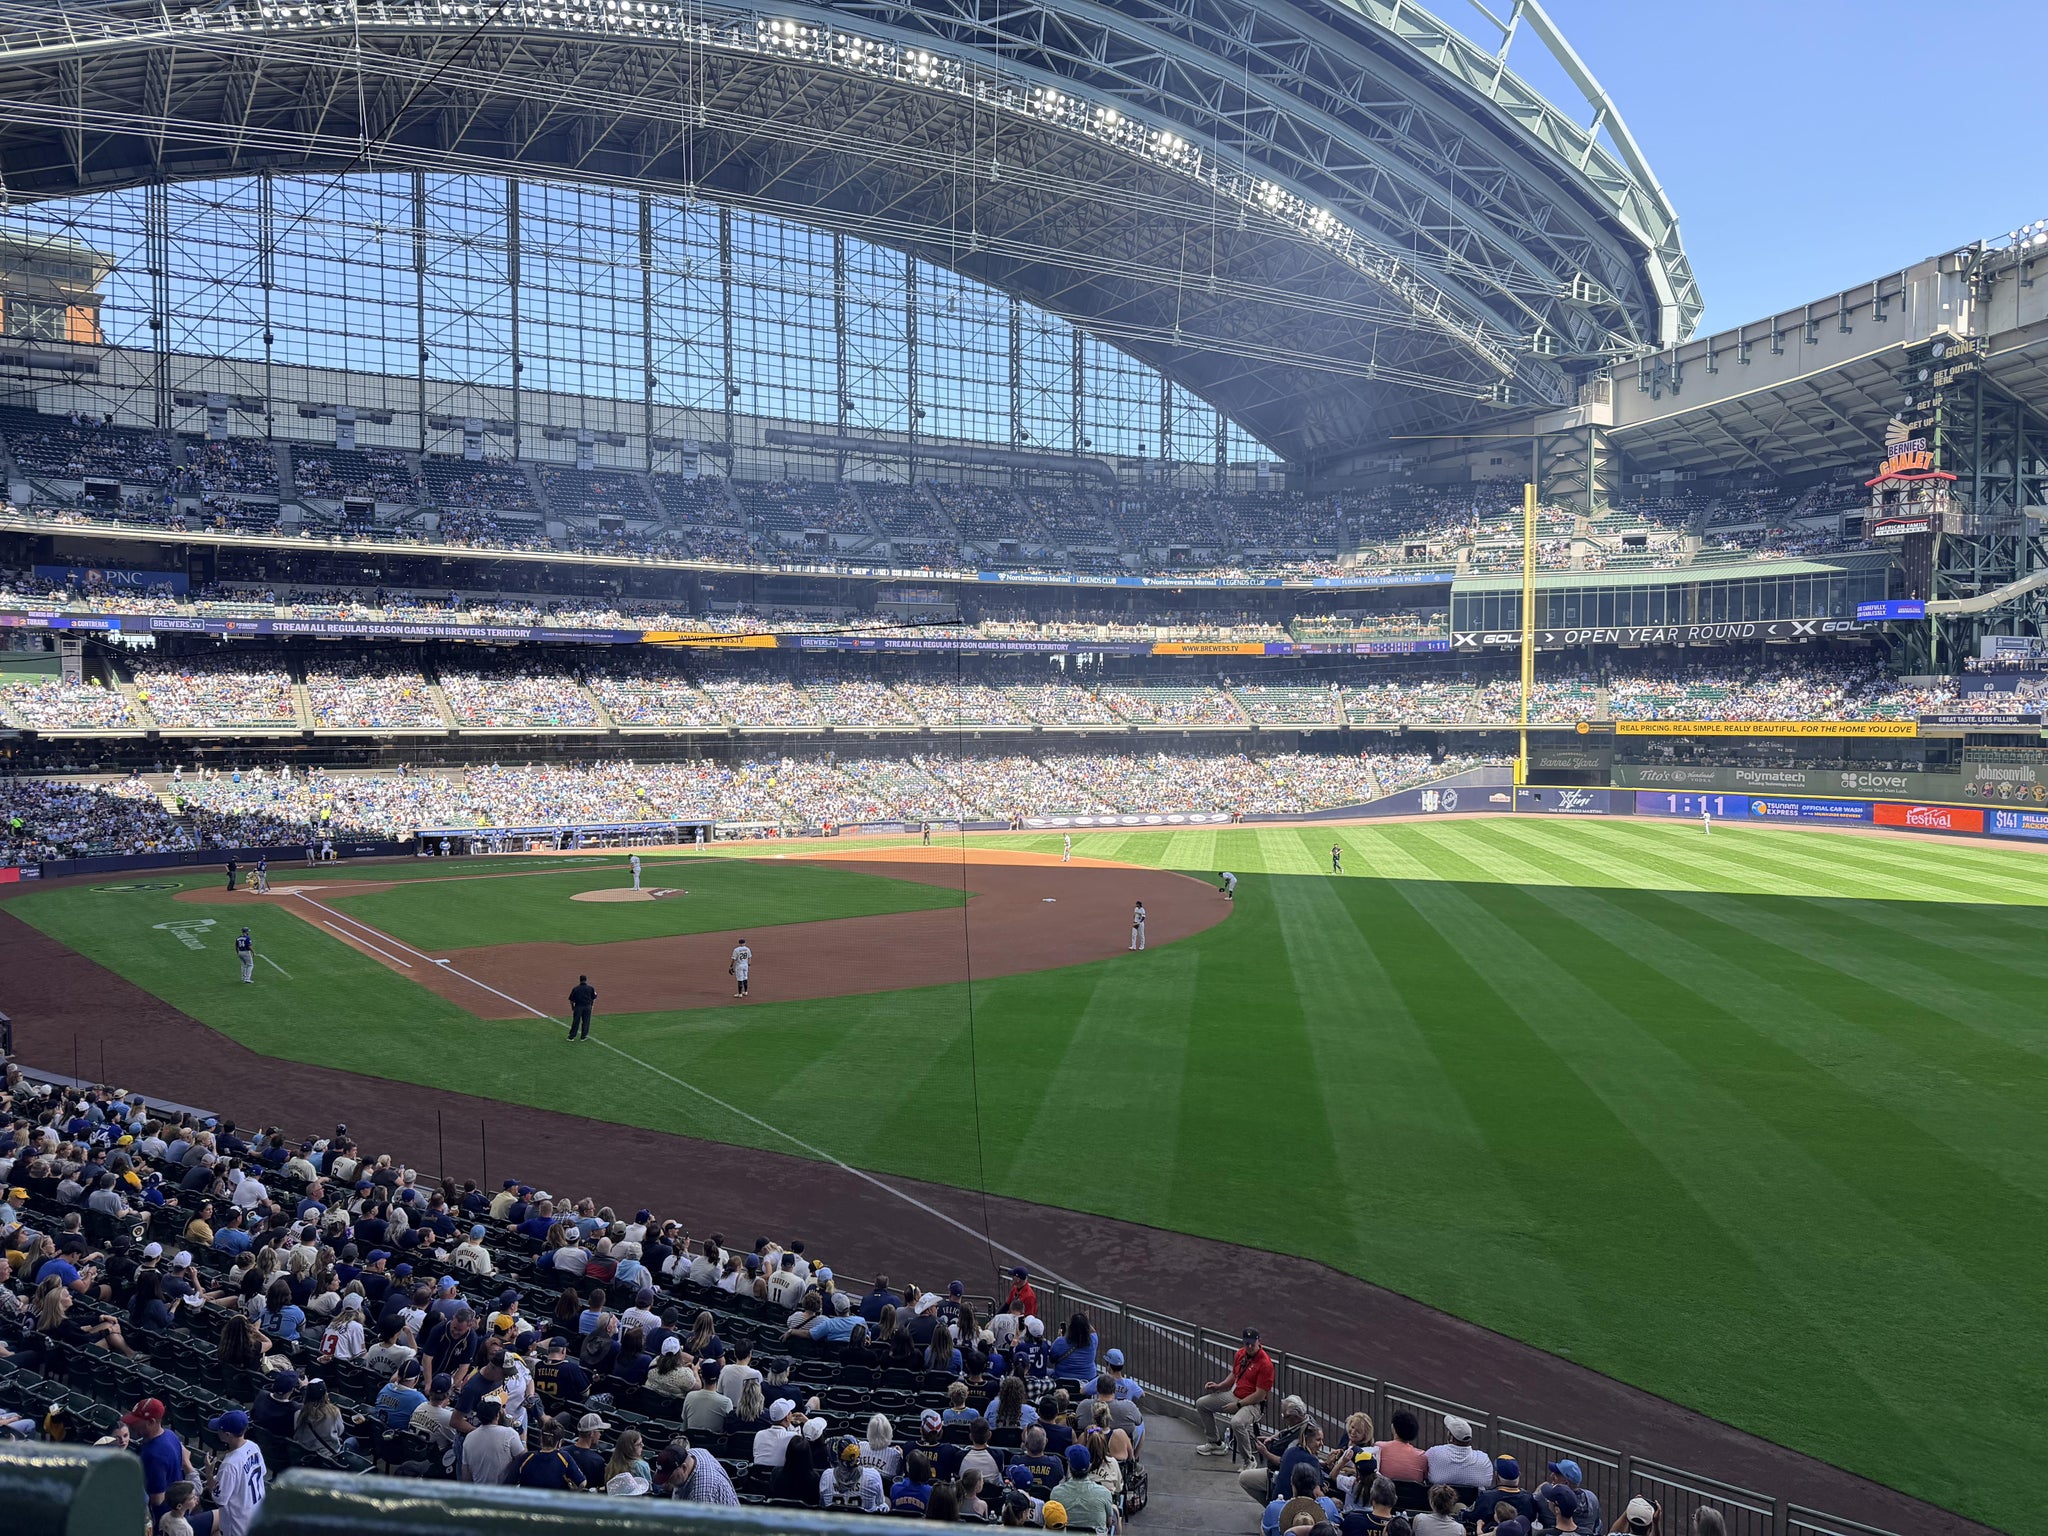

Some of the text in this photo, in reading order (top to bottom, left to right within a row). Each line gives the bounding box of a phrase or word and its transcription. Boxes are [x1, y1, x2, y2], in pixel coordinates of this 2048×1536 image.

[1945, 339, 1981, 359] GONE!
[1933, 362, 1974, 381] GET OUTTA
[1933, 375, 1954, 387] HERE
[1917, 397, 1943, 411] GET UP
[1908, 417, 1934, 431] GET UP
[1887, 437, 1926, 457] BERNIE'S
[1879, 449, 1934, 476] CHALET
[1876, 521, 1928, 531] AMERICAN FAMILY
[105, 571, 143, 587] PNC
[1006, 574, 1117, 585] Northwestern Mutual LEGENDS CLUB
[1380, 576, 1404, 584] TEQUILA
[77, 621, 109, 629] CONTRERAS
[153, 619, 202, 629] BREWERS.TV
[272, 622, 310, 632] STREAM
[310, 622, 326, 632] ALL
[328, 623, 368, 634] REGULAR
[369, 625, 404, 634] SEASON
[405, 626, 434, 635] GAMES
[435, 627, 442, 635] IN
[445, 627, 486, 636] BREWERS
[486, 628, 531, 638] TERRITORY
[1791, 621, 1817, 635] X
[1452, 633, 1478, 647] X
[1564, 624, 1755, 644] OPEN YEAR ROUND
[802, 638, 837, 646] BREWERS.TV
[884, 640, 913, 649] STREAM
[913, 640, 924, 648] ALL
[923, 640, 952, 649] REGULAR
[977, 642, 1000, 650] GAMES
[1036, 643, 1069, 652] TERRITORY
[1428, 642, 1446, 650] 1:11
[1181, 645, 1239, 653] WWW.BREWERS.TV
[1983, 683, 1995, 691] GO
[1938, 716, 1958, 724] GREAT
[1620, 724, 1913, 734] REAL PRICING. REAL SIMPLE. REALLY BEAUTIFUL. FOR THE HOME YOU LOVE
[1539, 757, 1599, 770] Barrel Yard
[1639, 769, 1670, 782] Tito's
[1735, 770, 1806, 785] Polymatech
[1975, 764, 2035, 783] Johnsonville
[1858, 773, 1908, 788] clover
[1666, 793, 1724, 817] 1:11
[1766, 802, 1799, 811] TSUNAMI
[1801, 804, 1829, 812] OFFICIAL
[1843, 806, 1864, 814] WASH
[1766, 809, 1799, 817] EXPRESS
[1905, 808, 1952, 830] festival
[1995, 810, 2018, 830] $141
[772, 1287, 781, 1303] 11
[942, 1306, 961, 1317] YELIC
[319, 1333, 339, 1356] 13
[1029, 1346, 1042, 1354] BETT
[537, 1368, 560, 1378] YELICH
[1028, 1465, 1052, 1476] RANG
[248, 1465, 262, 1505] 17
